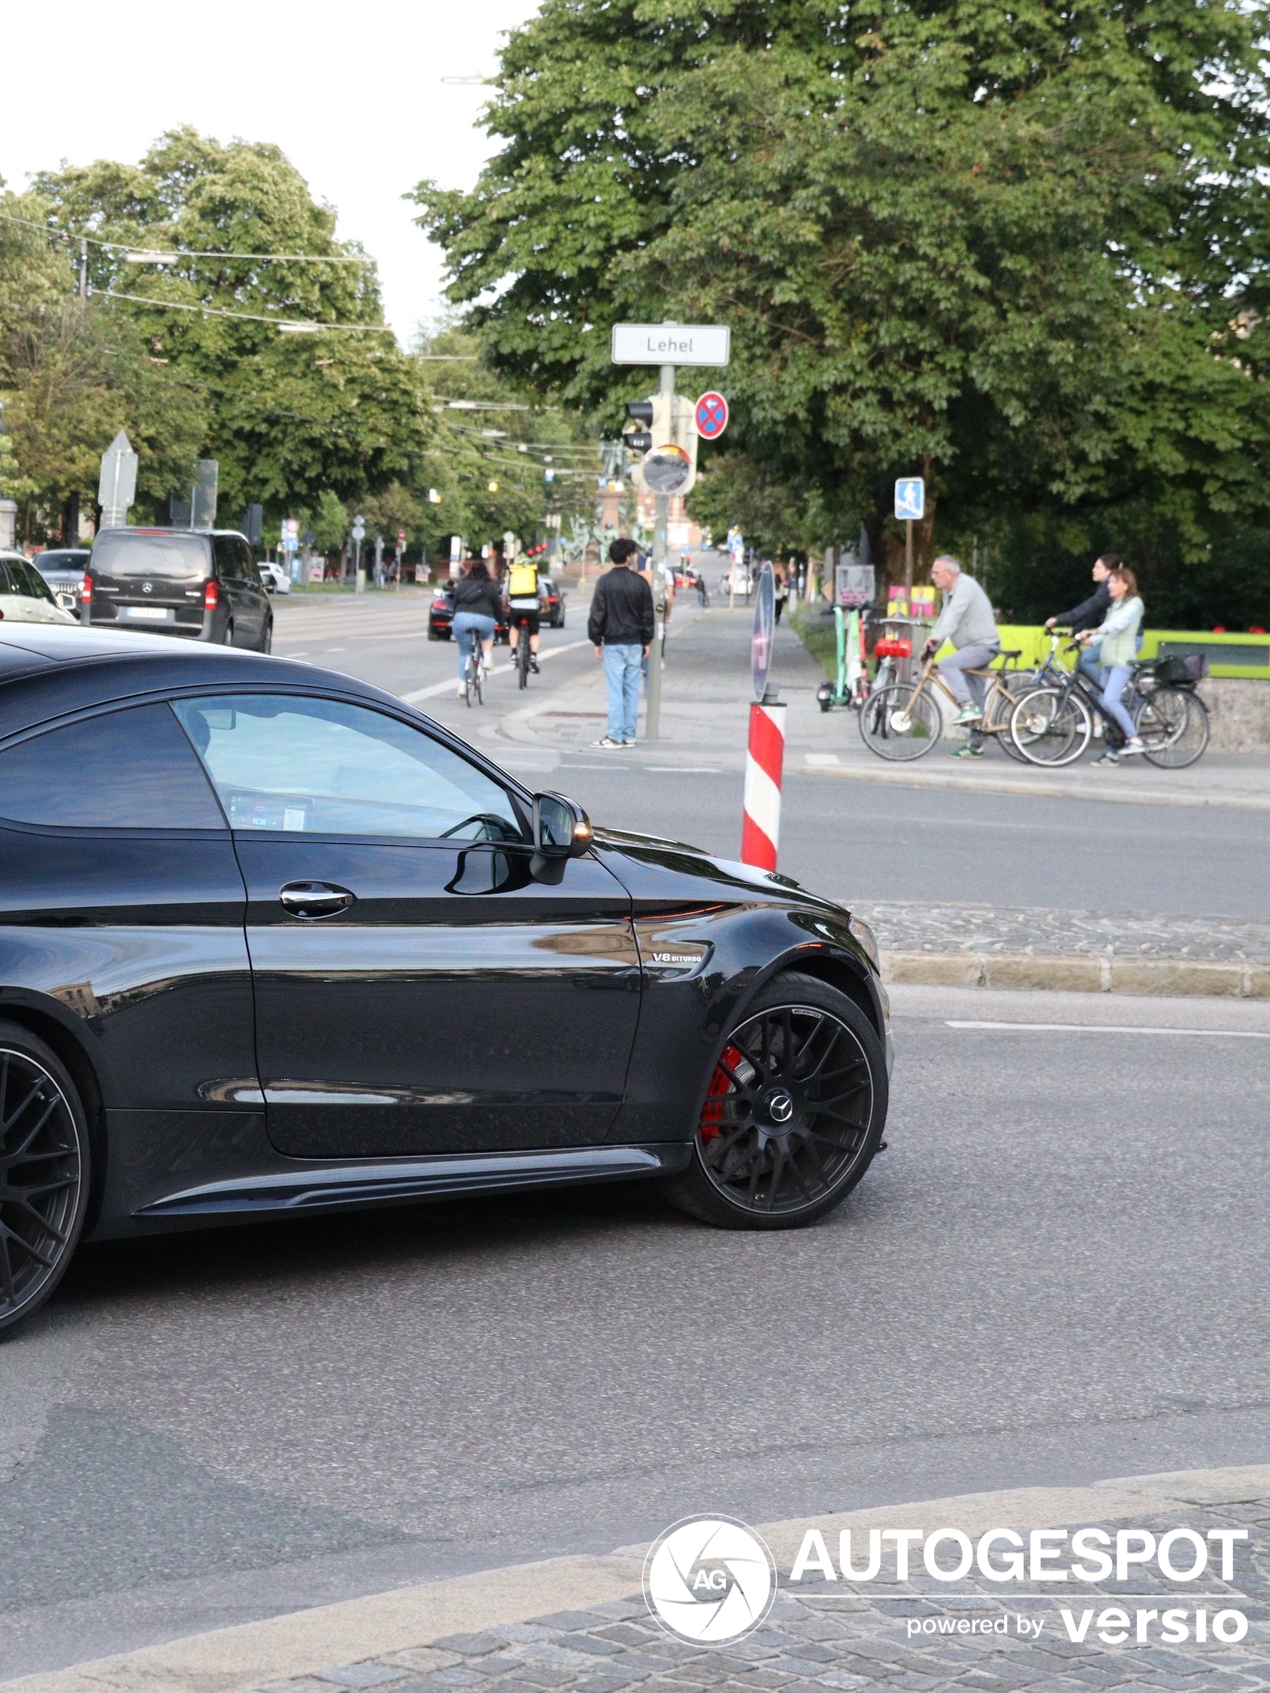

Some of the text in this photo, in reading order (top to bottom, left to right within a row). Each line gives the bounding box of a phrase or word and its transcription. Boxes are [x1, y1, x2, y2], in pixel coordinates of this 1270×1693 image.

[647, 337, 693, 352] Lehel
[652, 953, 702, 963] V8 BITURBO
